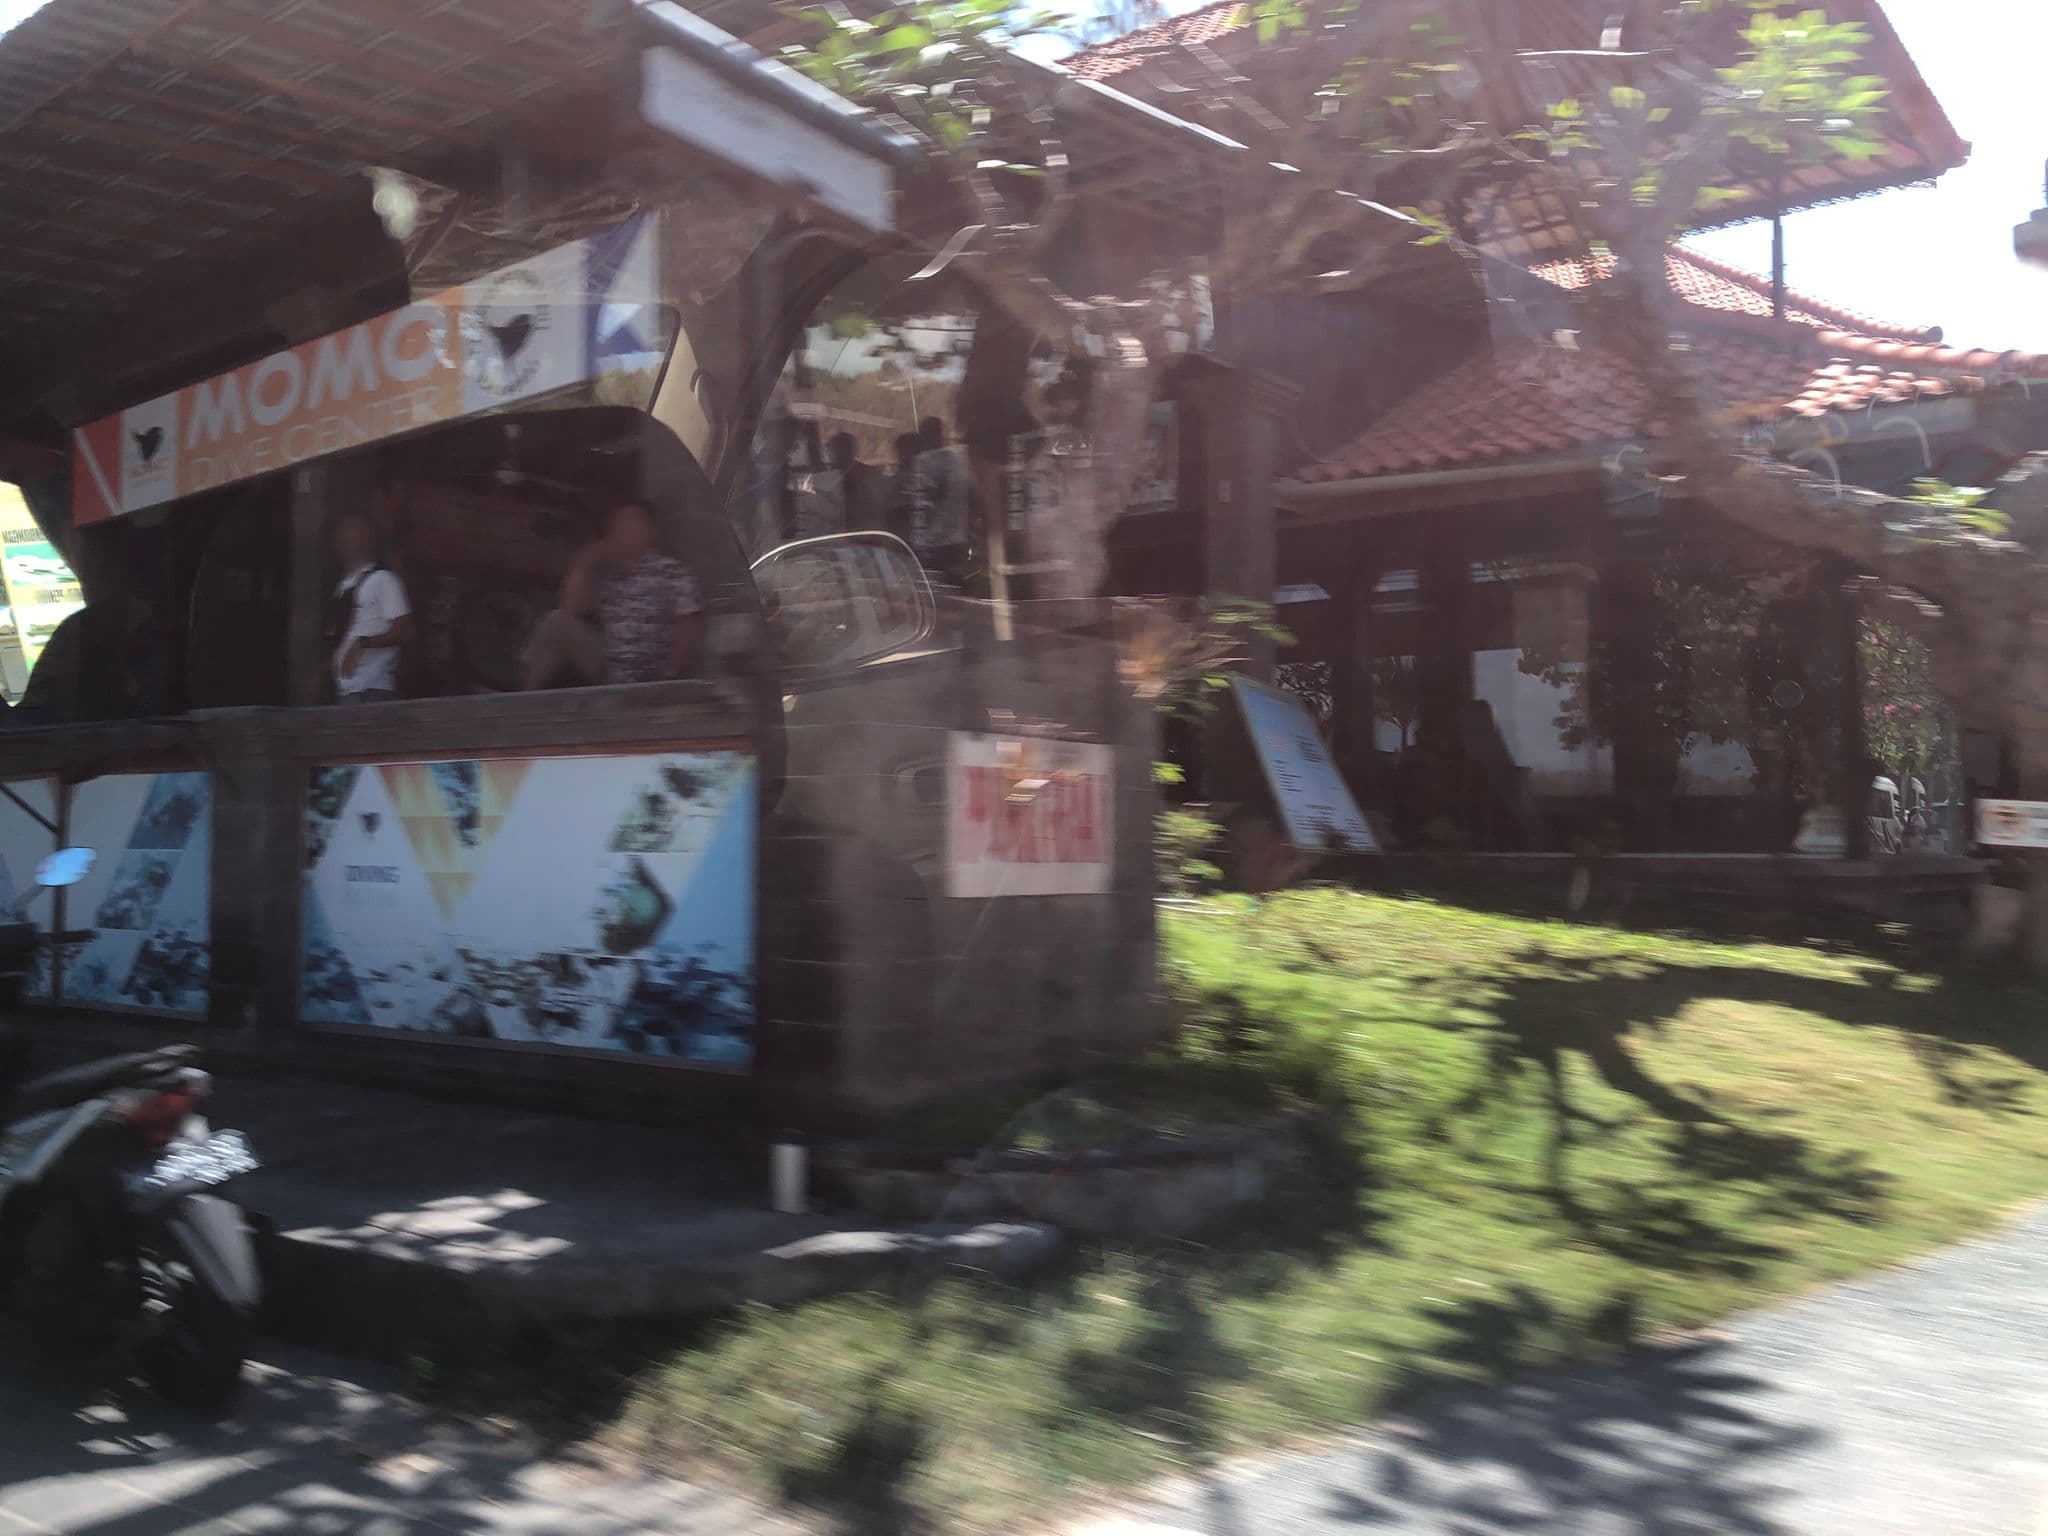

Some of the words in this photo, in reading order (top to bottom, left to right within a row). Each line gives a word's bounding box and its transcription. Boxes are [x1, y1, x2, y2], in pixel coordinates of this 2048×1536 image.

[188, 302, 449, 448] MOMO
[190, 437, 273, 491] DIVE
[280, 386, 441, 462] CENTER
